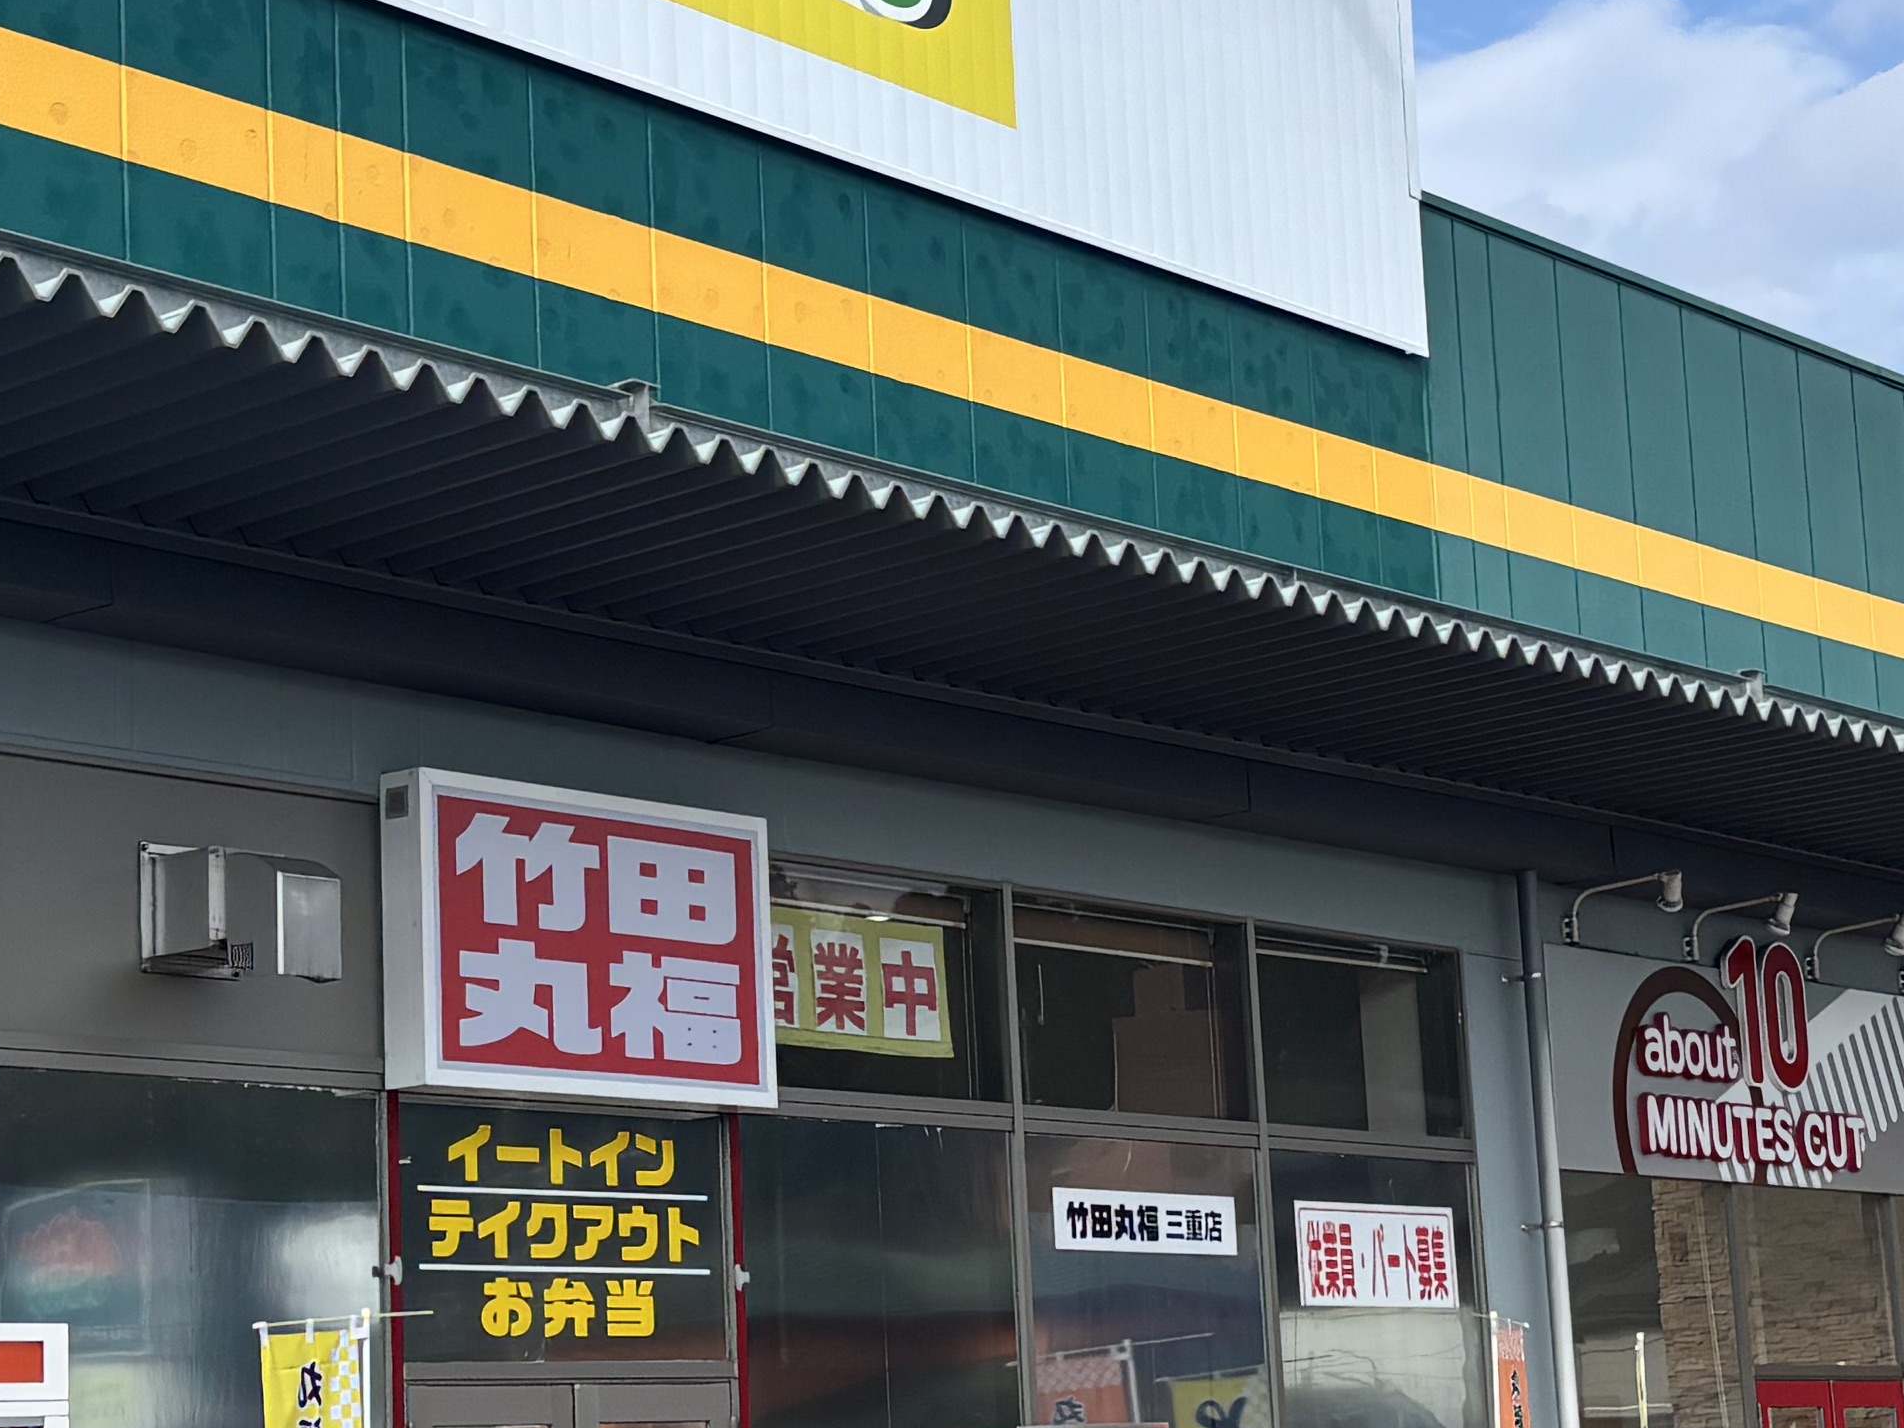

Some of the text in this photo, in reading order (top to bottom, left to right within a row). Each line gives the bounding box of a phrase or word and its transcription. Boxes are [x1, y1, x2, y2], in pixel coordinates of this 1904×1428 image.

[455, 812, 736, 946] 竹田
[458, 937, 743, 1065] 丸福
[1643, 935, 1809, 1093] about 10
[447, 1125, 675, 1187] イートイン
[1646, 1097, 1865, 1172] MINUTES CUT
[428, 1199, 700, 1262] テイクアウト
[1065, 1199, 1223, 1244] 竹田丸福 三重店
[480, 1277, 656, 1338] お弁当
